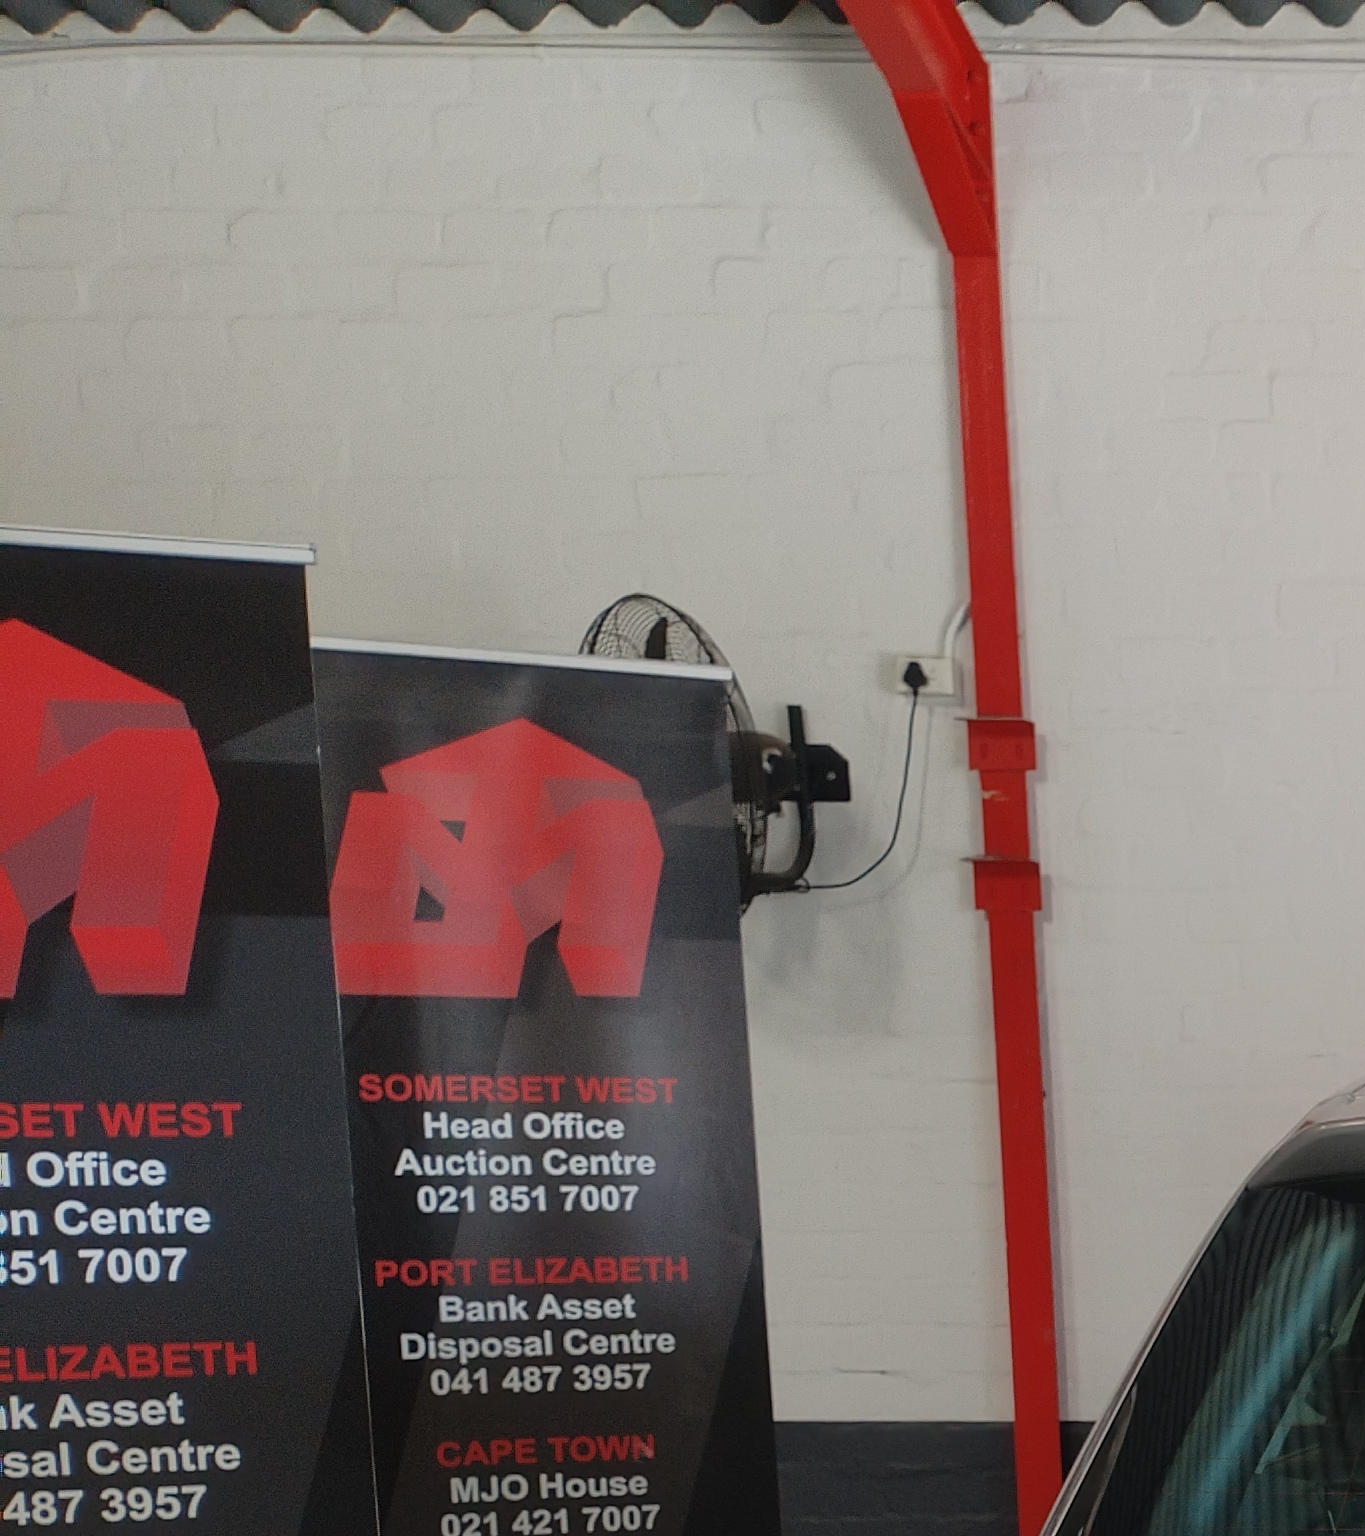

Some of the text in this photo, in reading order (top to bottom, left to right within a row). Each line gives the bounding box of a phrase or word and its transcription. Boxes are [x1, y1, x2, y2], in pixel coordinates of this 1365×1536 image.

[358, 1073, 678, 1103] SOMERSET WEST
[97, 1101, 242, 1138] WEST
[423, 1111, 625, 1139] Head Office
[26, 1151, 167, 1187] Office
[394, 1148, 656, 1176] Auction Centre
[417, 1185, 640, 1213] 021 851 7007
[54, 1200, 211, 1235] Centre
[77, 1247, 188, 1284] 7007
[374, 1256, 689, 1288] PORT ELIZABETH
[439, 1293, 636, 1323] Bank Asset
[400, 1329, 676, 1365] Disposal Centre
[430, 1363, 651, 1395] 041 487 3957
[49, 1391, 186, 1429] Asset
[86, 1439, 241, 1475] Centre
[436, 1434, 656, 1468] CAPE TOWN
[450, 1472, 648, 1504] MJO House
[3, 1484, 207, 1526] 487 3957
[511, 1508, 569, 1535] 421
[582, 1504, 660, 1534] 7007
